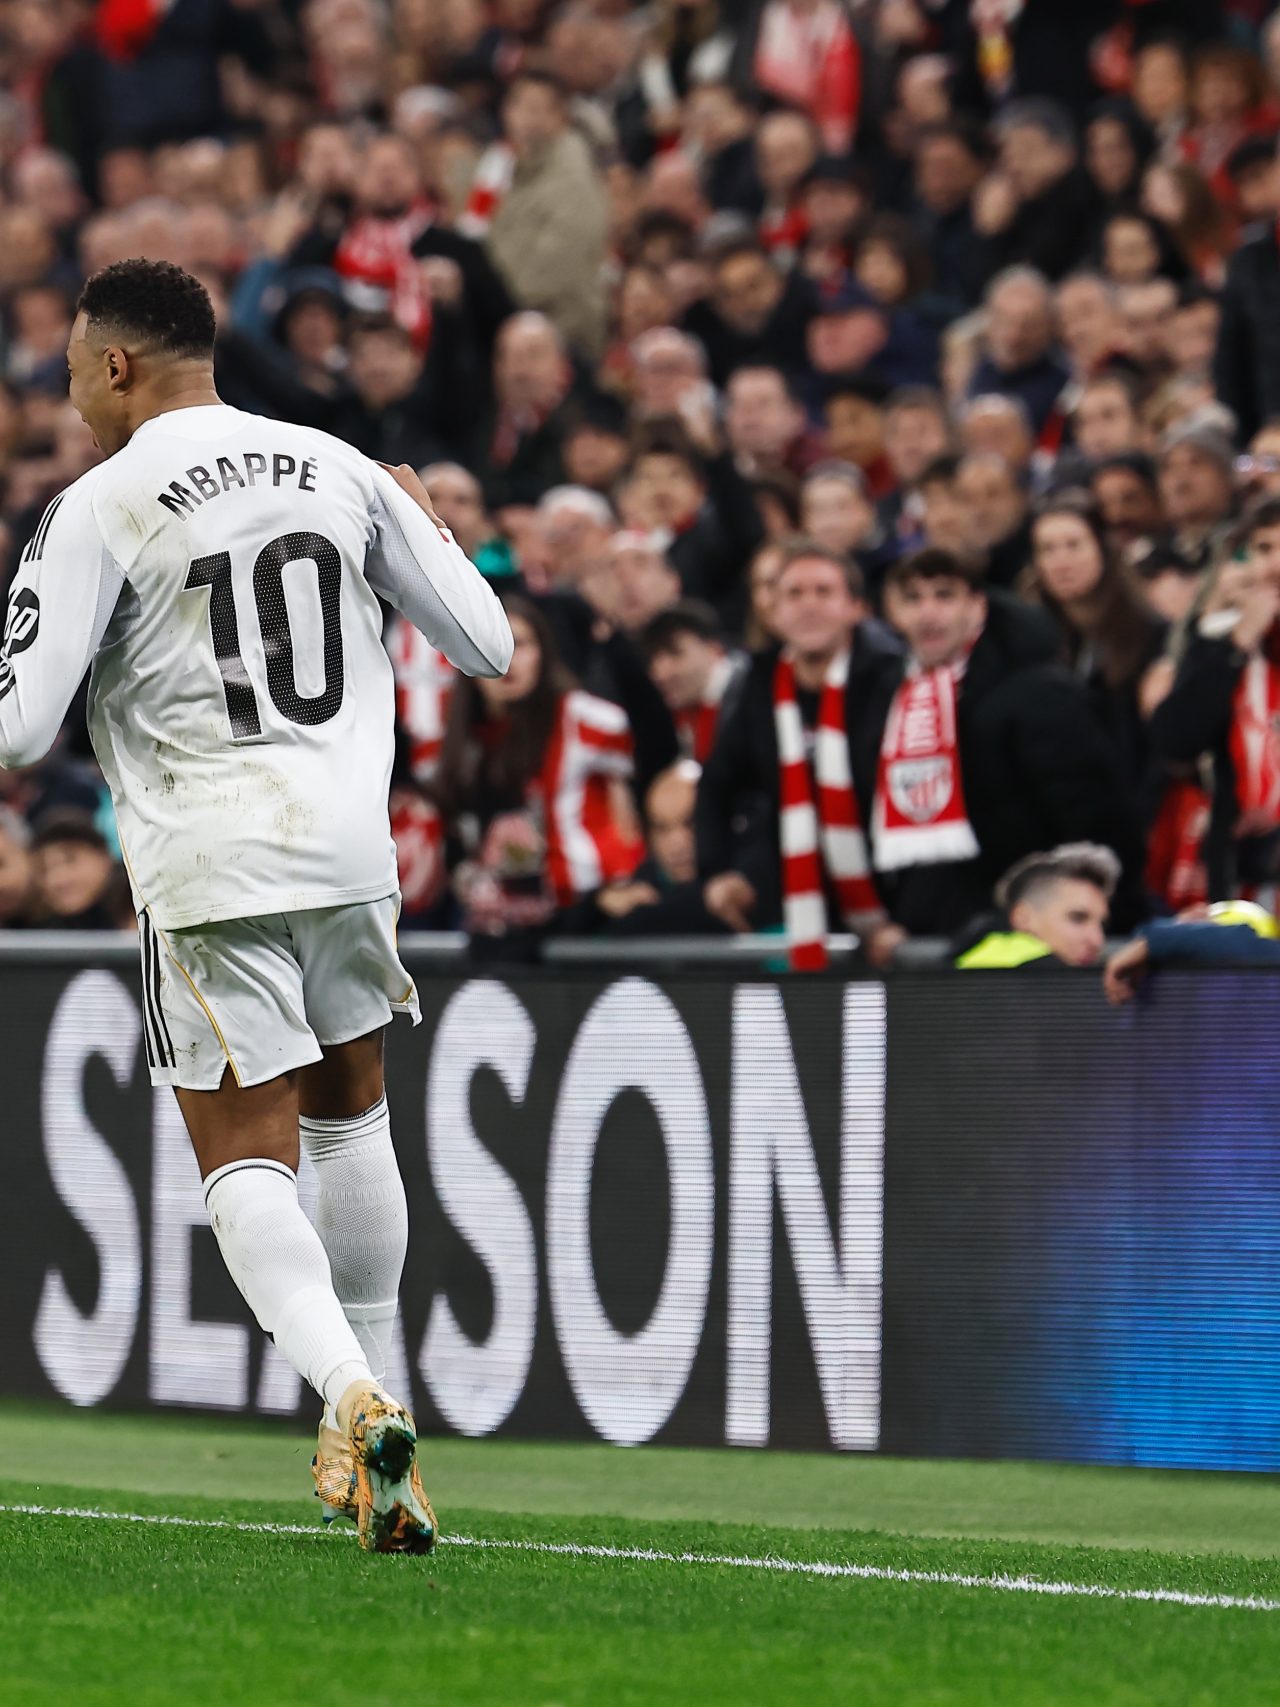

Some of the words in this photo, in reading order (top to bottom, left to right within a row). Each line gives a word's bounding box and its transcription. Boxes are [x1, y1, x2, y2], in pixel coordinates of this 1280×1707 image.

[157, 453, 318, 521] MBAPPÉ
[183, 532, 344, 739] 10
[33, 968, 886, 1451] SESON
